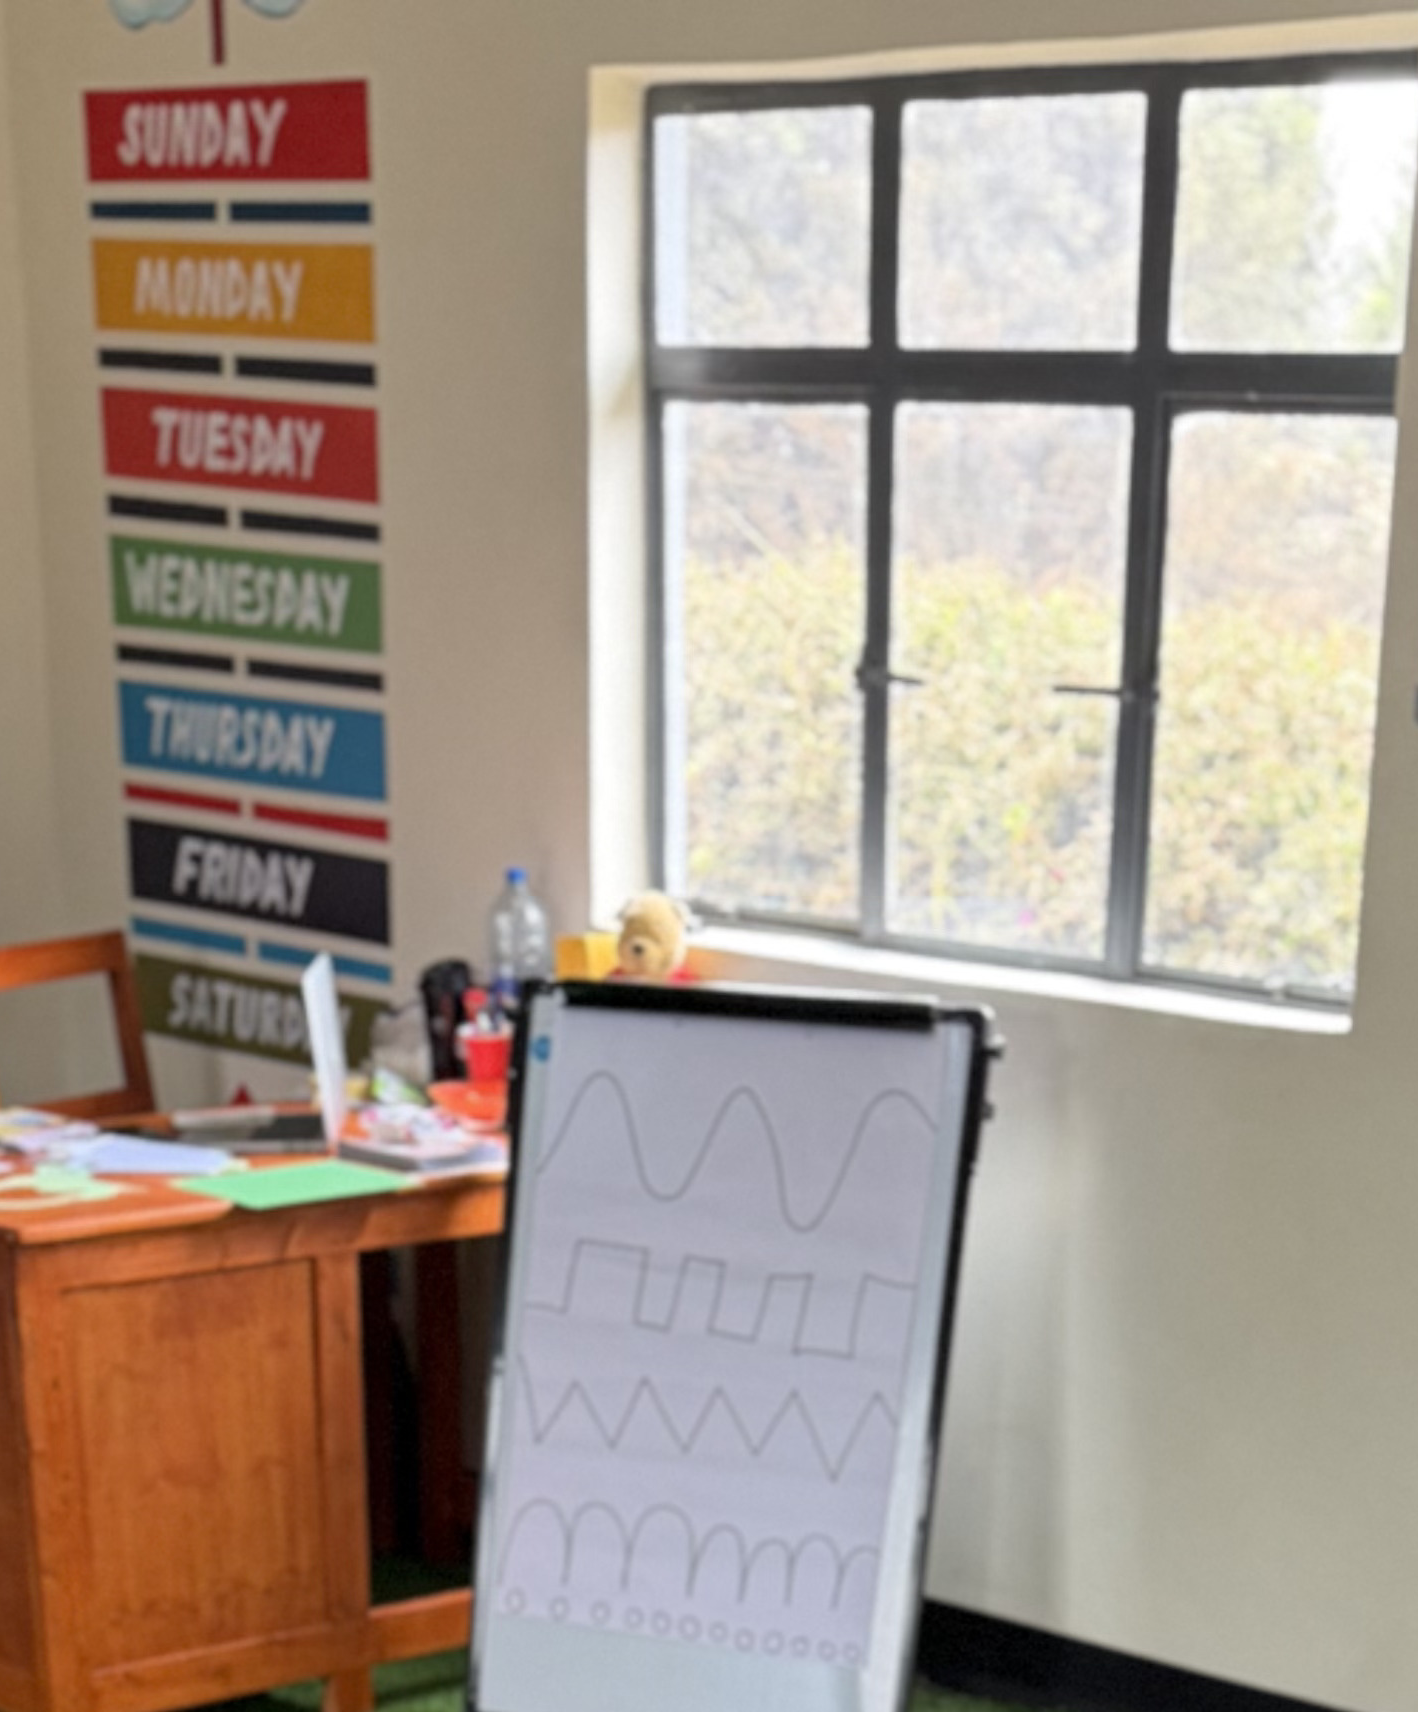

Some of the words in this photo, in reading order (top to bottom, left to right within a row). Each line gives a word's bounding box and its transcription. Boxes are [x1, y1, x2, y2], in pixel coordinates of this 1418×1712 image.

[116, 97, 288, 169] SUNDAY
[134, 256, 304, 323] MONDAY
[150, 407, 324, 480] TUESDAY
[123, 550, 349, 638] WEDNESDAY
[143, 696, 336, 779] THURSDAY
[172, 836, 315, 918] FRIDAY
[168, 973, 350, 1049] SATURD
